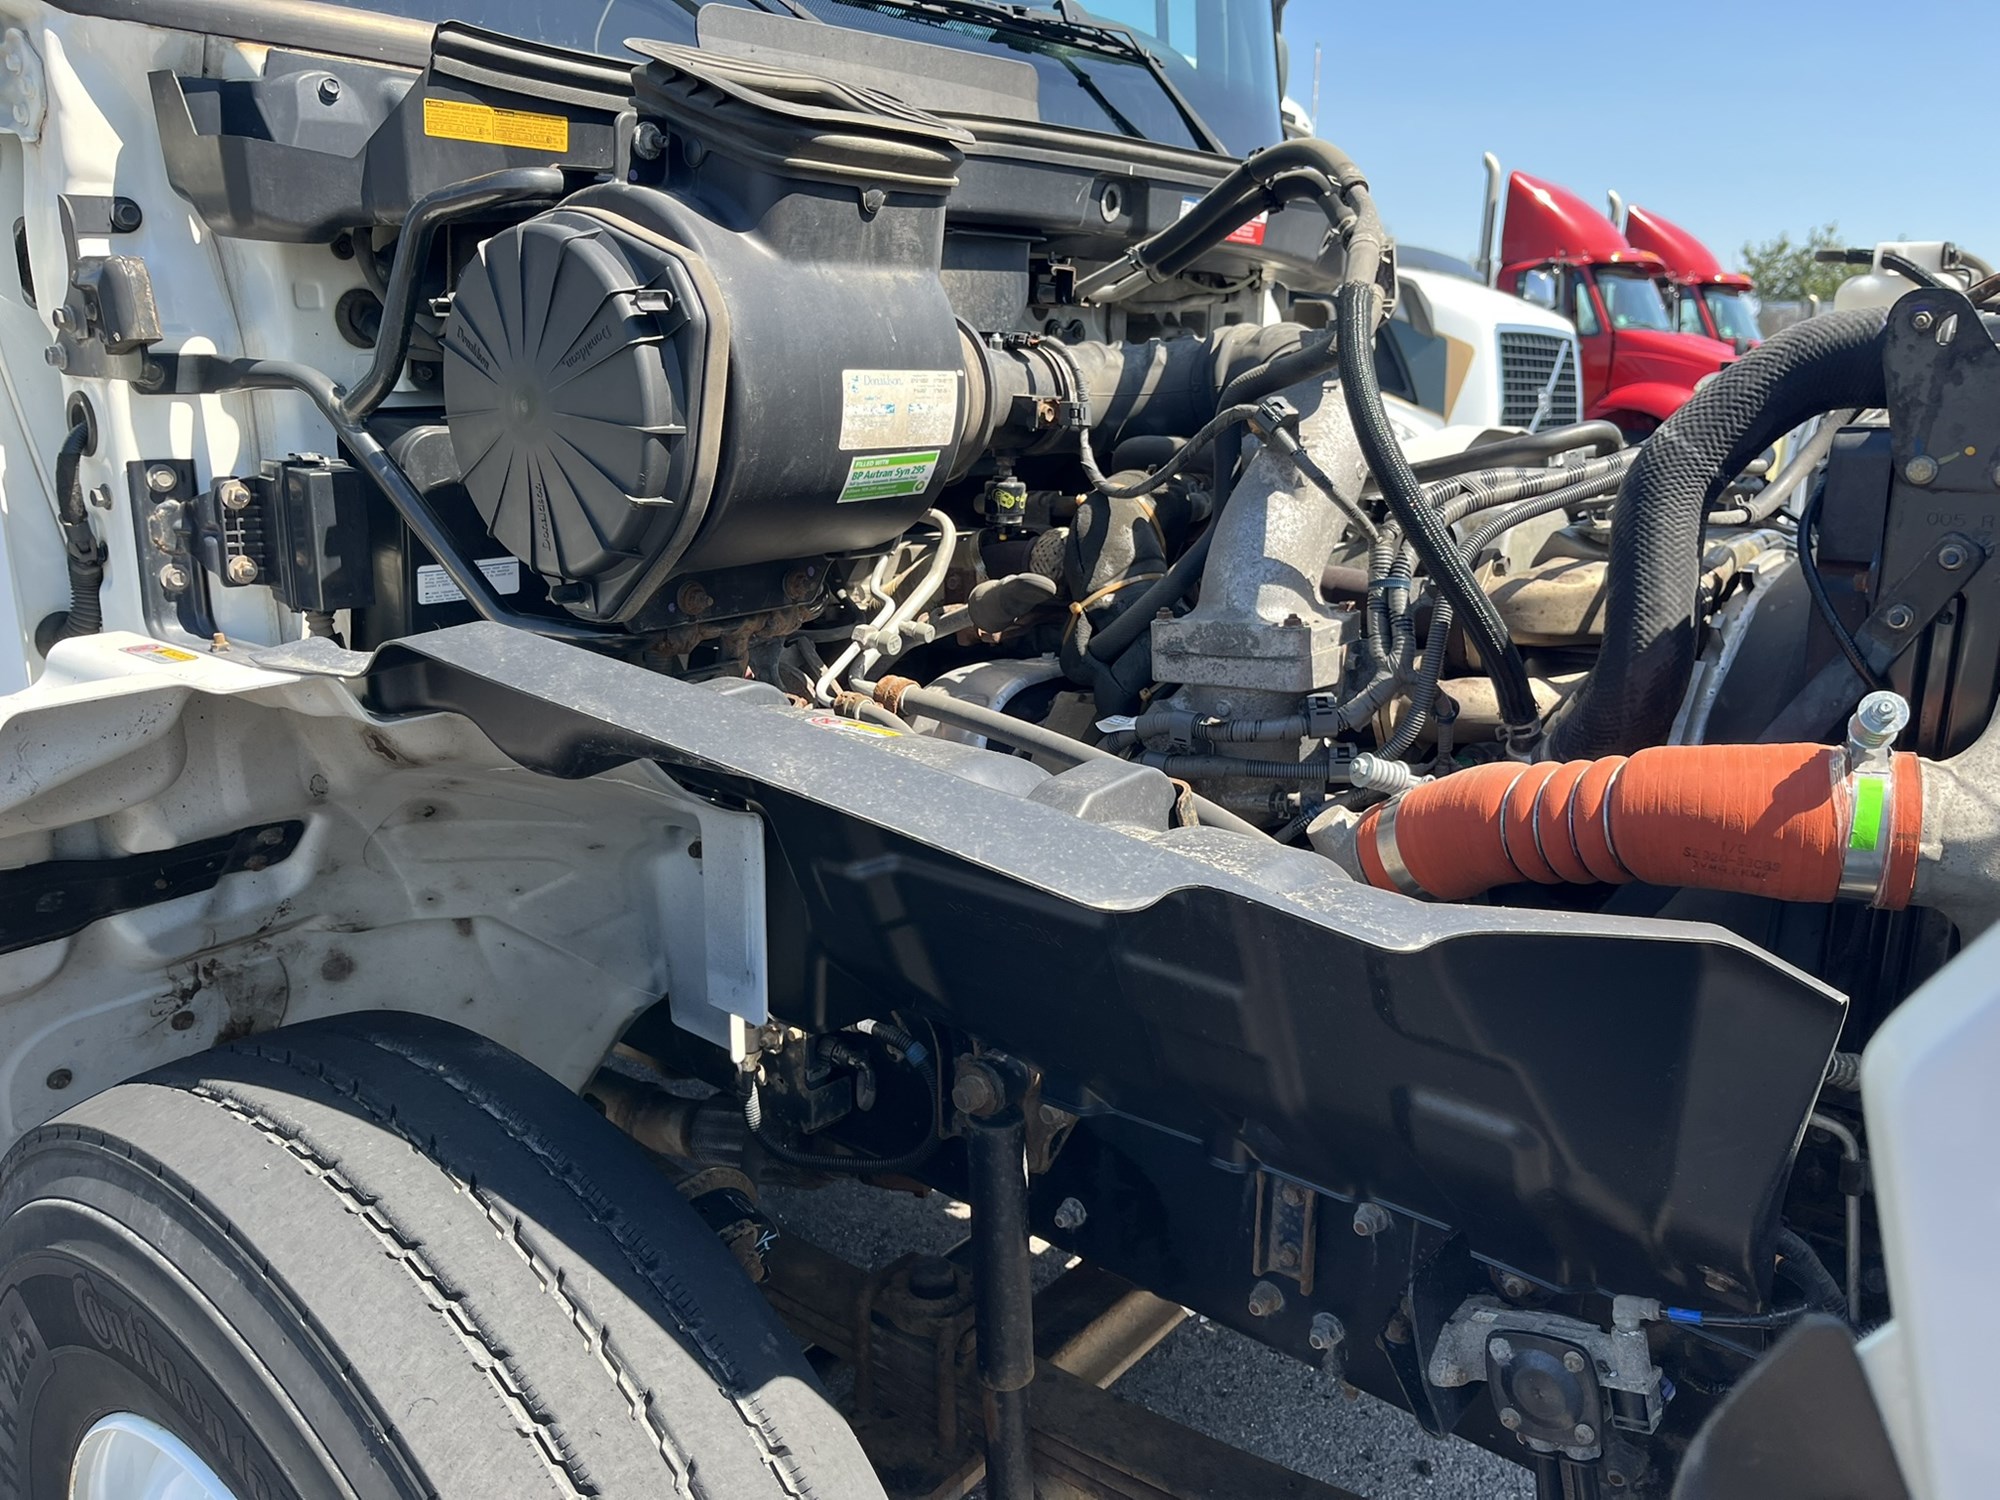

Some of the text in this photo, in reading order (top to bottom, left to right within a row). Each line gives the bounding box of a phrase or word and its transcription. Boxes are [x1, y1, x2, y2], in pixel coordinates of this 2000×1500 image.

[855, 460, 875, 468] FILLED
[851, 465, 926, 481] BP Autran Syn 295
[72, 1271, 290, 1500] Continent
